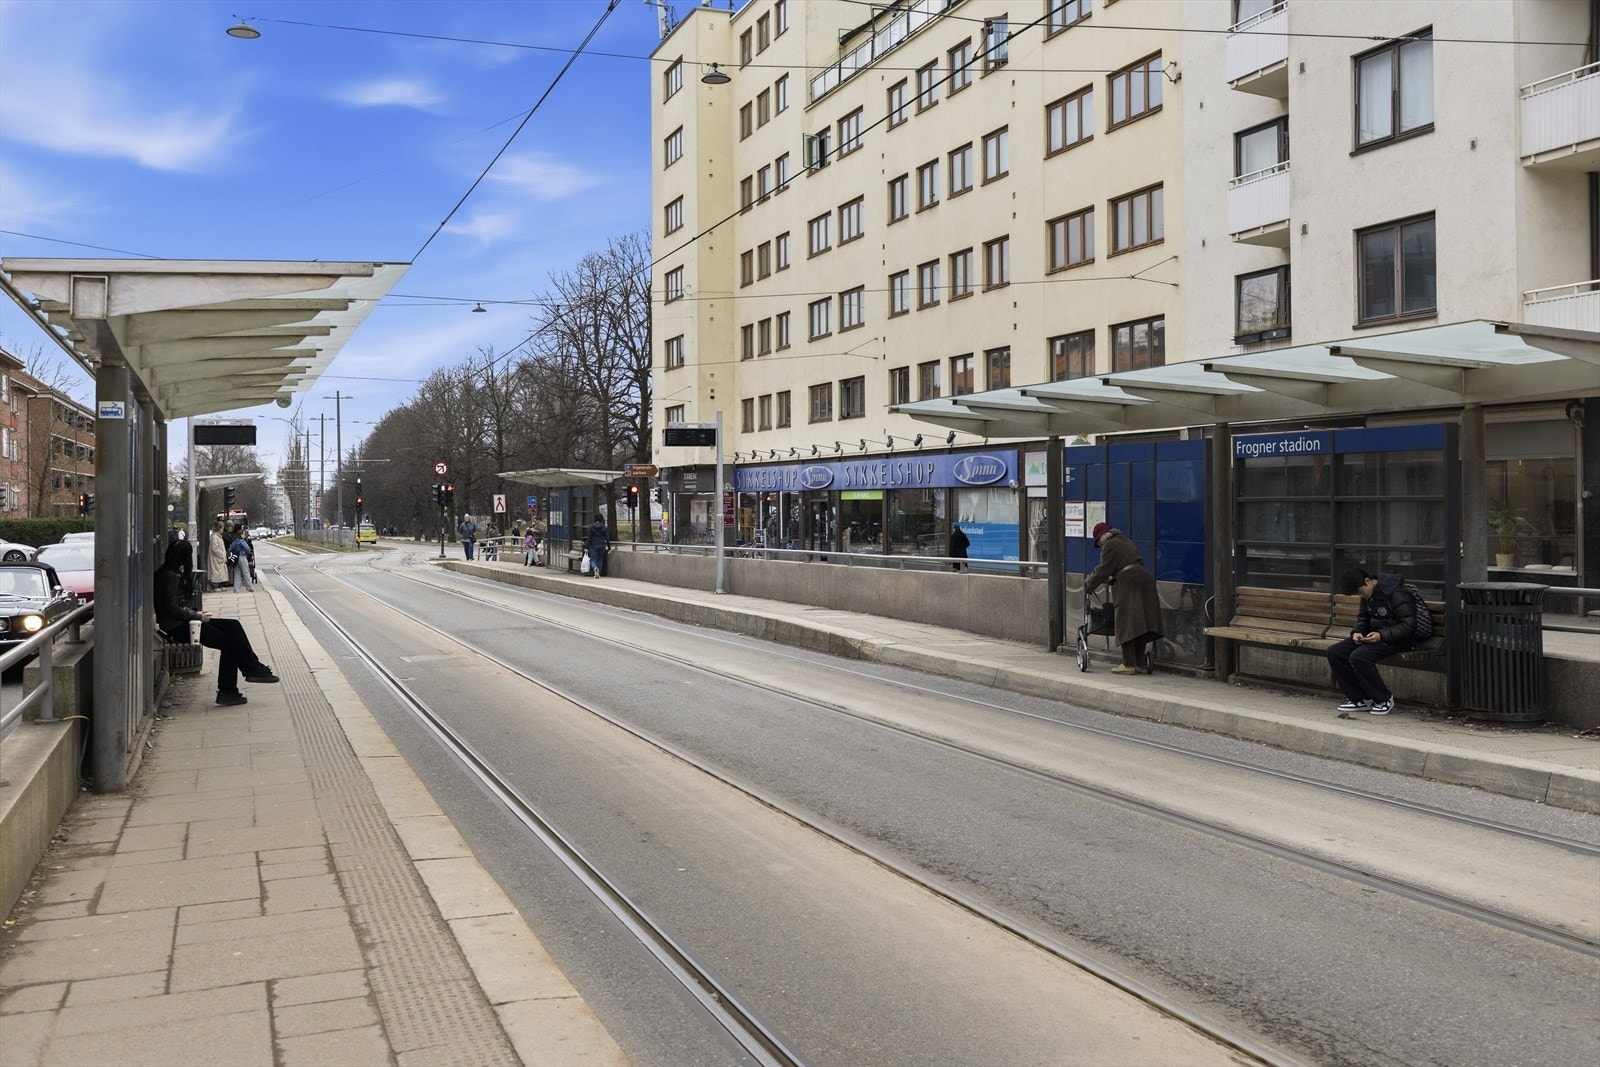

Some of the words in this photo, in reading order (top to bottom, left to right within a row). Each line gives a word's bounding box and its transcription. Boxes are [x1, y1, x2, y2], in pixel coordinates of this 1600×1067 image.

[1236, 441, 1277, 457] Frogner
[1279, 437, 1321, 453] stadion
[736, 469, 798, 489] SYKKELSHOP
[803, 466, 828, 487] Spinn
[845, 461, 935, 486] SYKKELSHOP
[958, 457, 997, 482] Spinn
